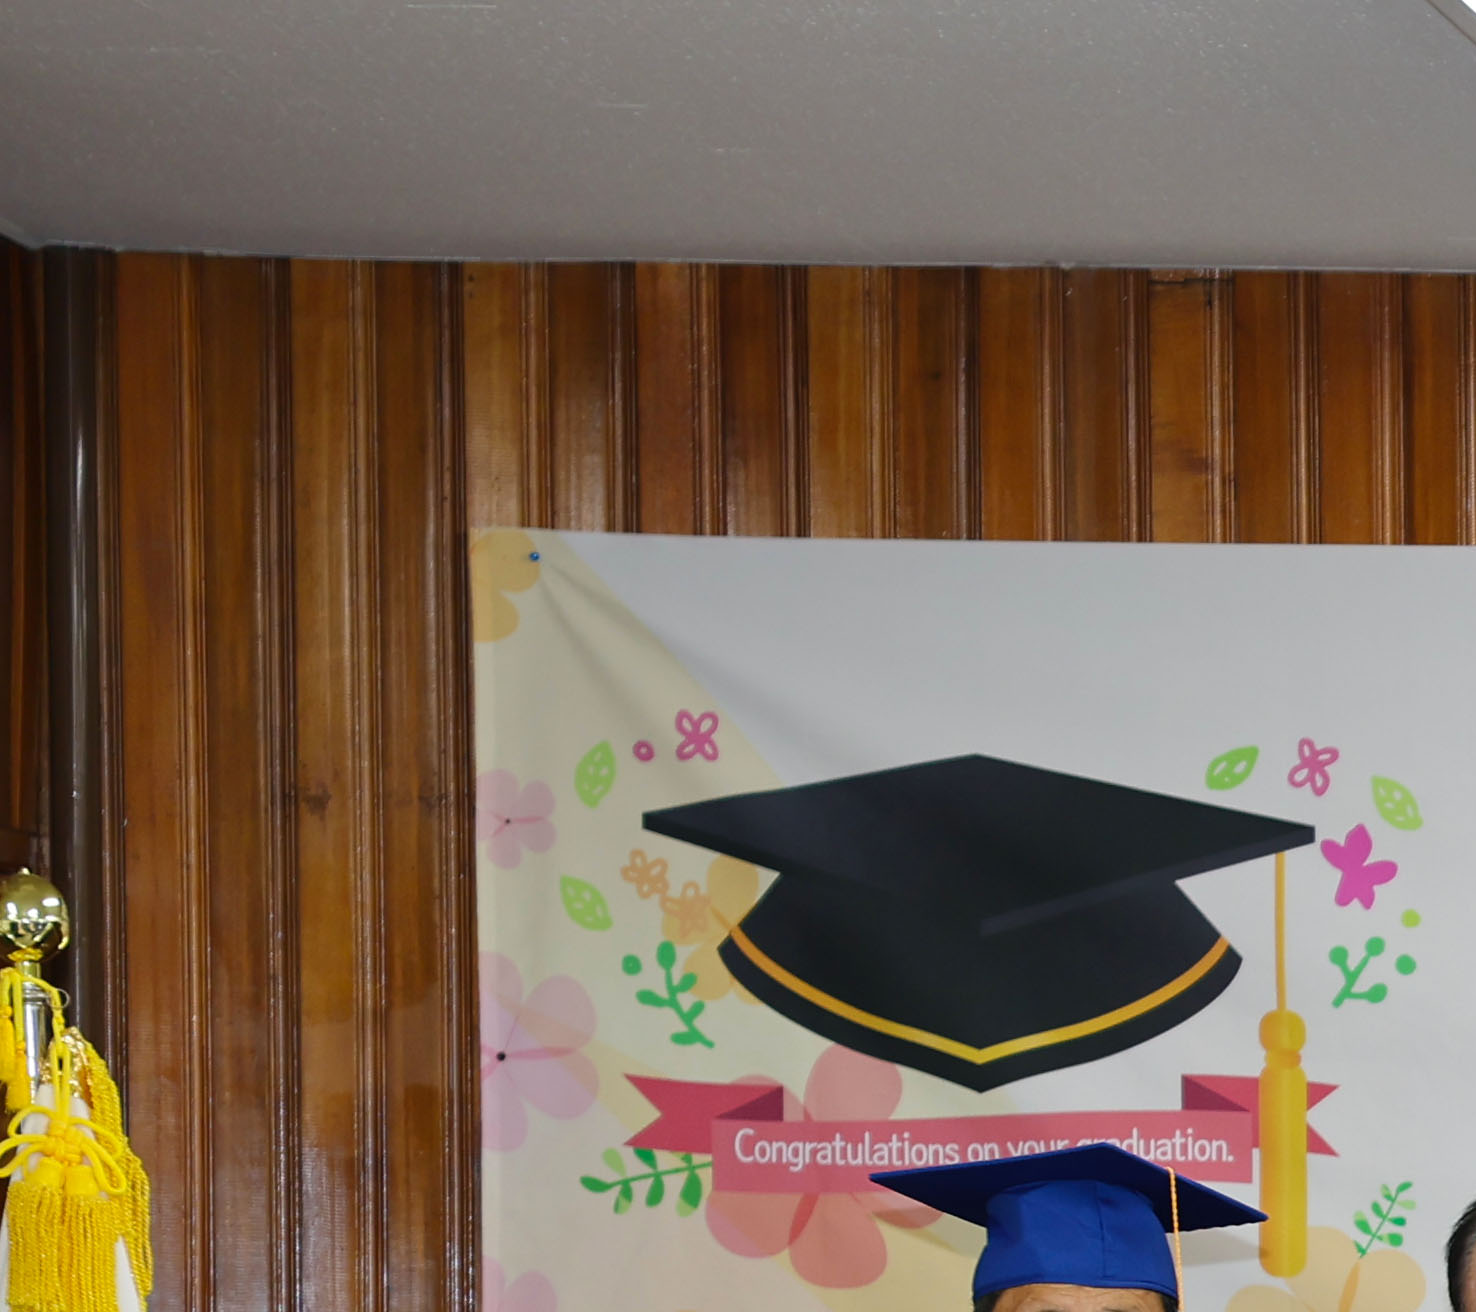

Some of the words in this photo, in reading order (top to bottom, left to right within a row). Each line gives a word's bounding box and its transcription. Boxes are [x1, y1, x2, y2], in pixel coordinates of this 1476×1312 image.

[733, 1127, 961, 1173] Congratulations
[966, 1141, 1001, 1163] on
[1076, 1126, 1236, 1165] duation.
